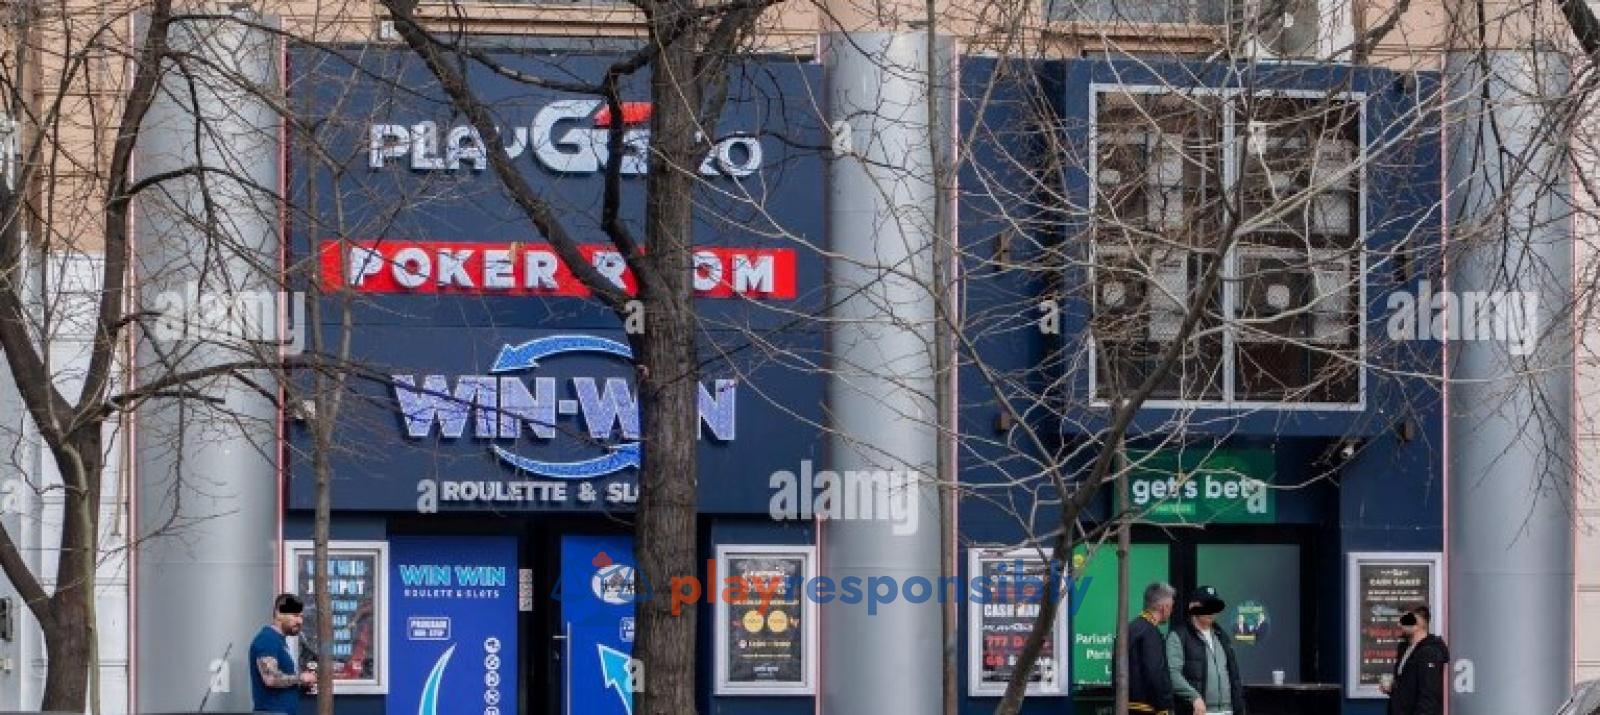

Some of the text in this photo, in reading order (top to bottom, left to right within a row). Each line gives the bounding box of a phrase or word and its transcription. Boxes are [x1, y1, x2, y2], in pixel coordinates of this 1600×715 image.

[349, 248, 775, 294] POKER ROM
[391, 374, 738, 441] WIN-WN
[442, 481, 566, 502] ROULETTE
[578, 482, 597, 501] &
[400, 564, 506, 587] WIN WIN
